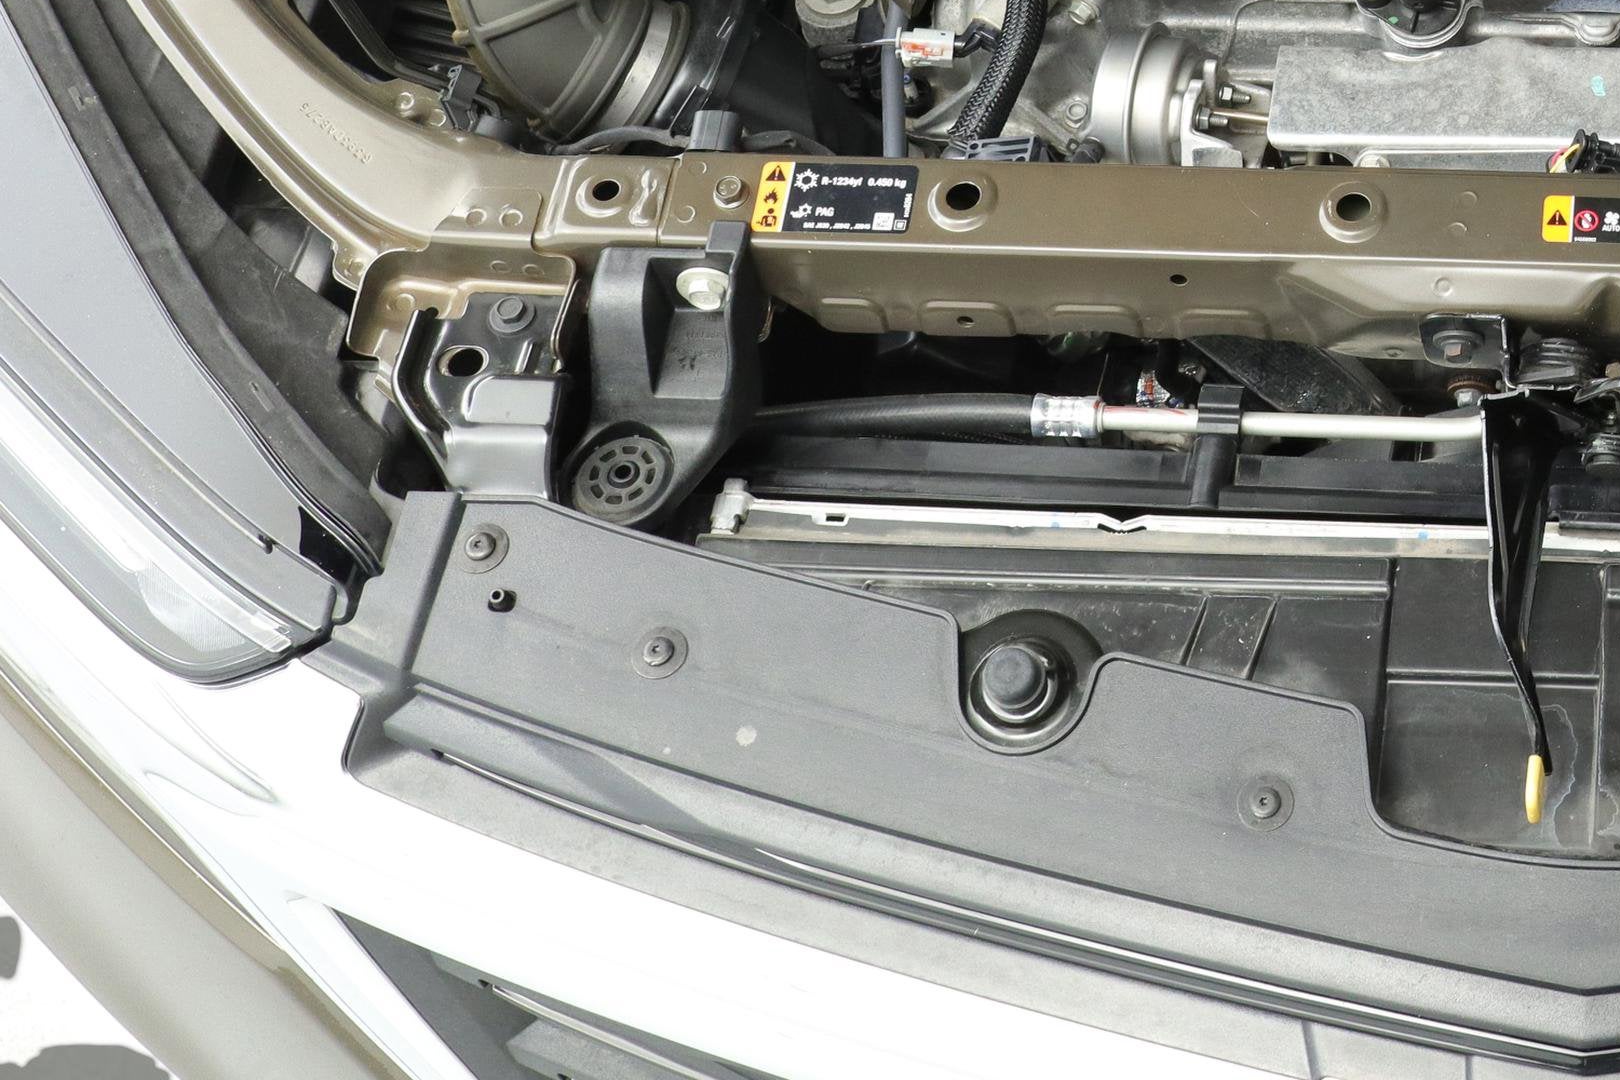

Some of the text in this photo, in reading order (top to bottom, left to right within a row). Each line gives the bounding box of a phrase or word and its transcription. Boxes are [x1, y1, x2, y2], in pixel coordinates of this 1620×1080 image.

[821, 176, 863, 188] R-1234yf
[894, 178, 907, 189] kg
[815, 206, 834, 217] PAG
